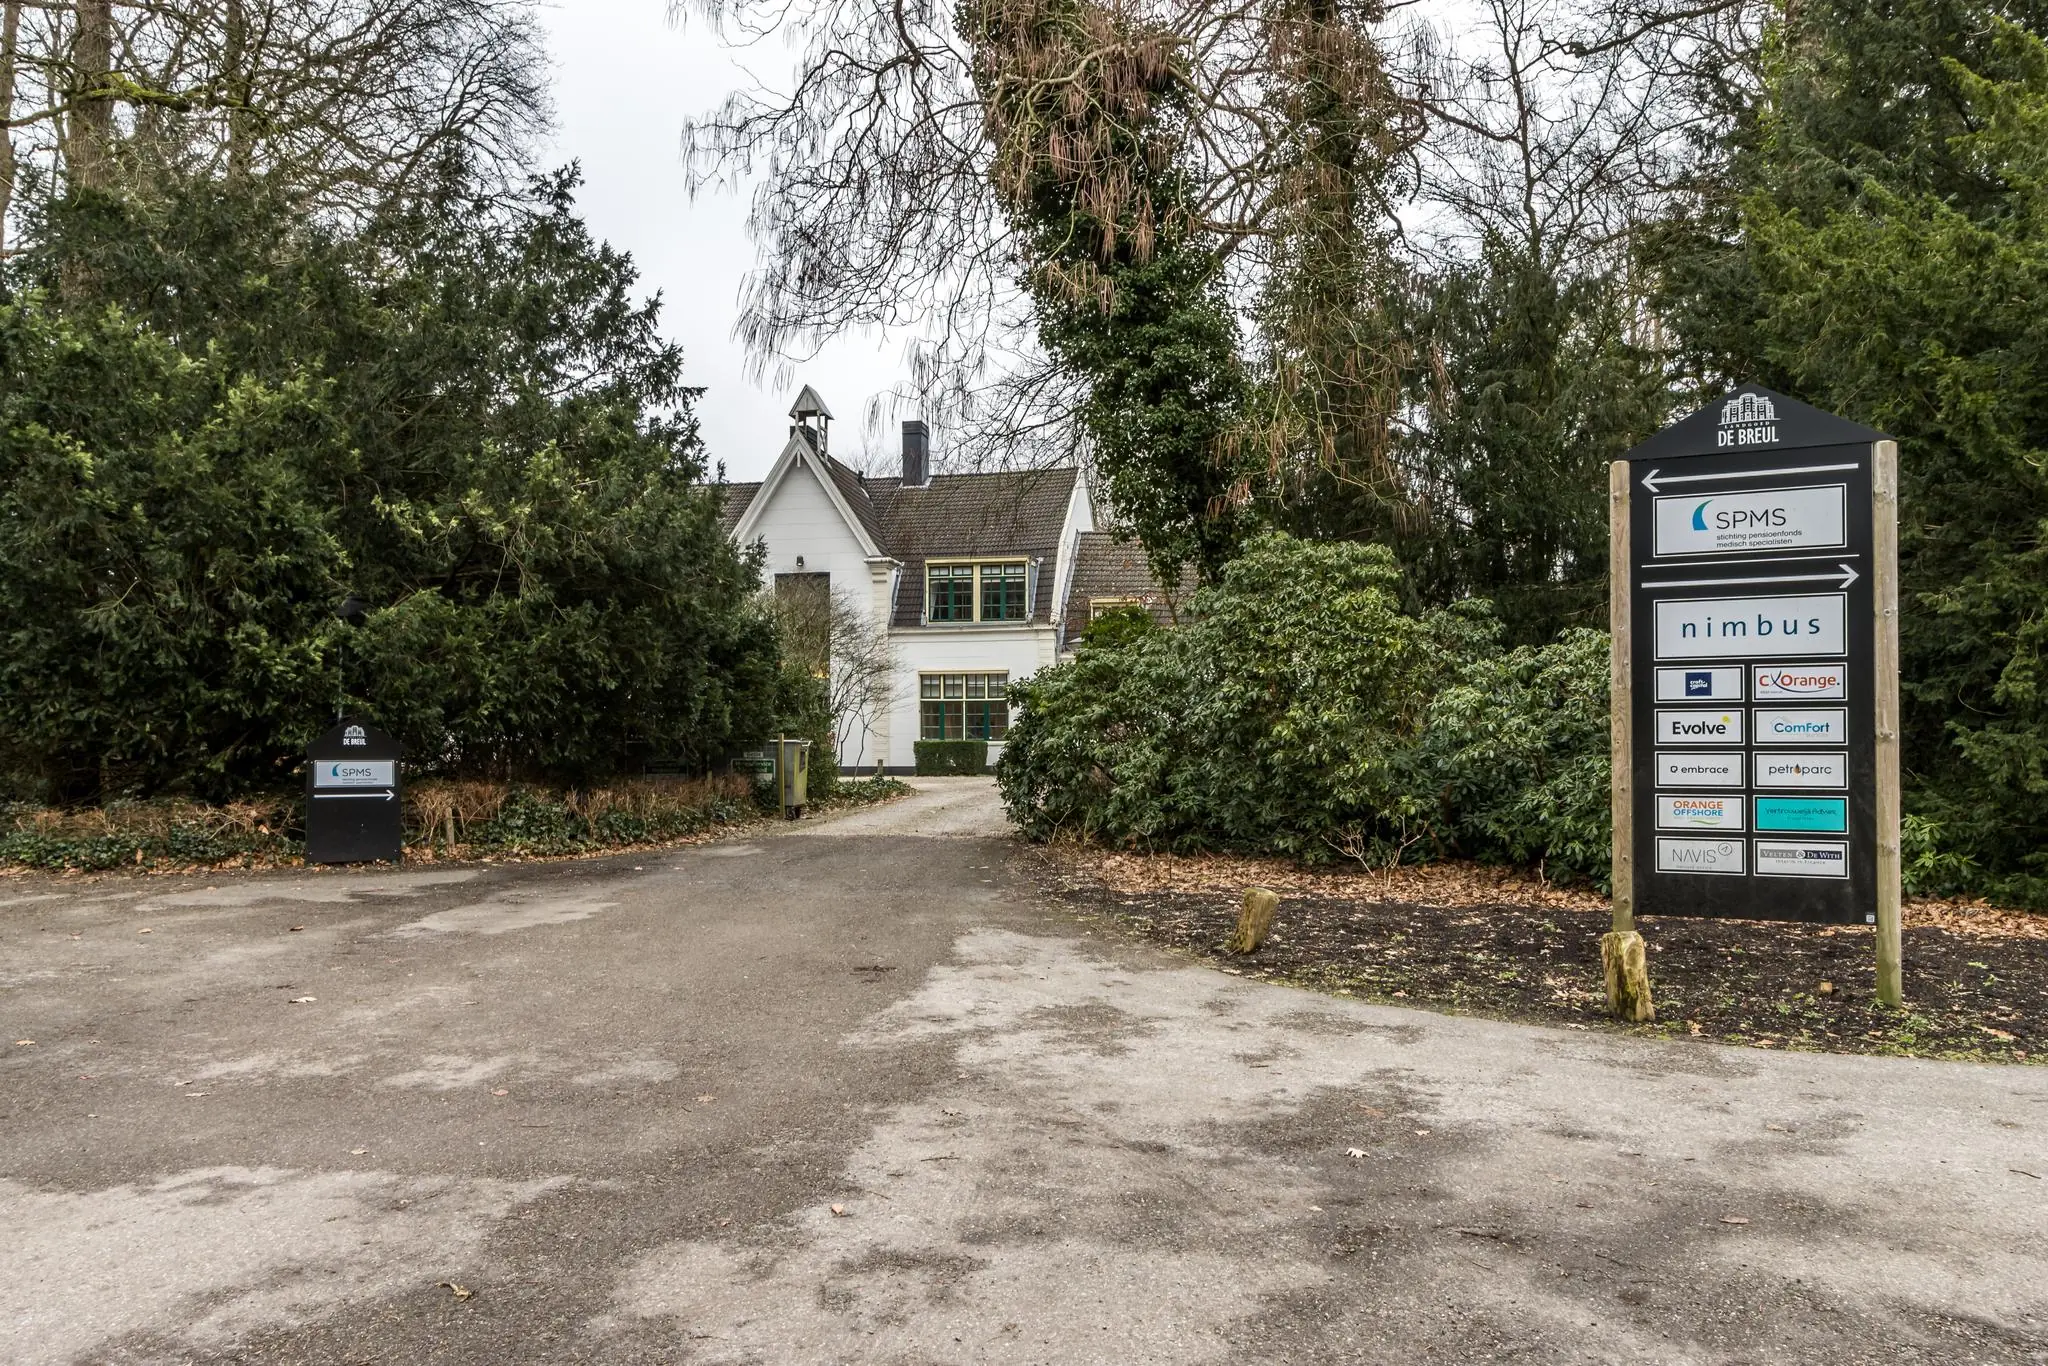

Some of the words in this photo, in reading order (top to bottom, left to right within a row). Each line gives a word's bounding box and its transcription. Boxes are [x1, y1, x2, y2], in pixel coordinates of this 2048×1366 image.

[1718, 430, 1735, 447] DE
[1738, 426, 1780, 445] BREUL
[1716, 508, 1787, 530] SPMS
[1716, 532, 1747, 541] stichting
[1748, 529, 1803, 540] pensioenfonds
[1716, 540, 1747, 548] medisch
[1682, 614, 1821, 638] nimbus
[1672, 721, 1727, 735] Evolve
[342, 768, 372, 777] SPMS
[1681, 765, 1729, 774] embrace
[1768, 763, 1832, 776] petroparc
[1673, 800, 1723, 809] ORANGE
[1673, 808, 1723, 817] OFFSHORE
[1672, 848, 1717, 864] NAVIS
